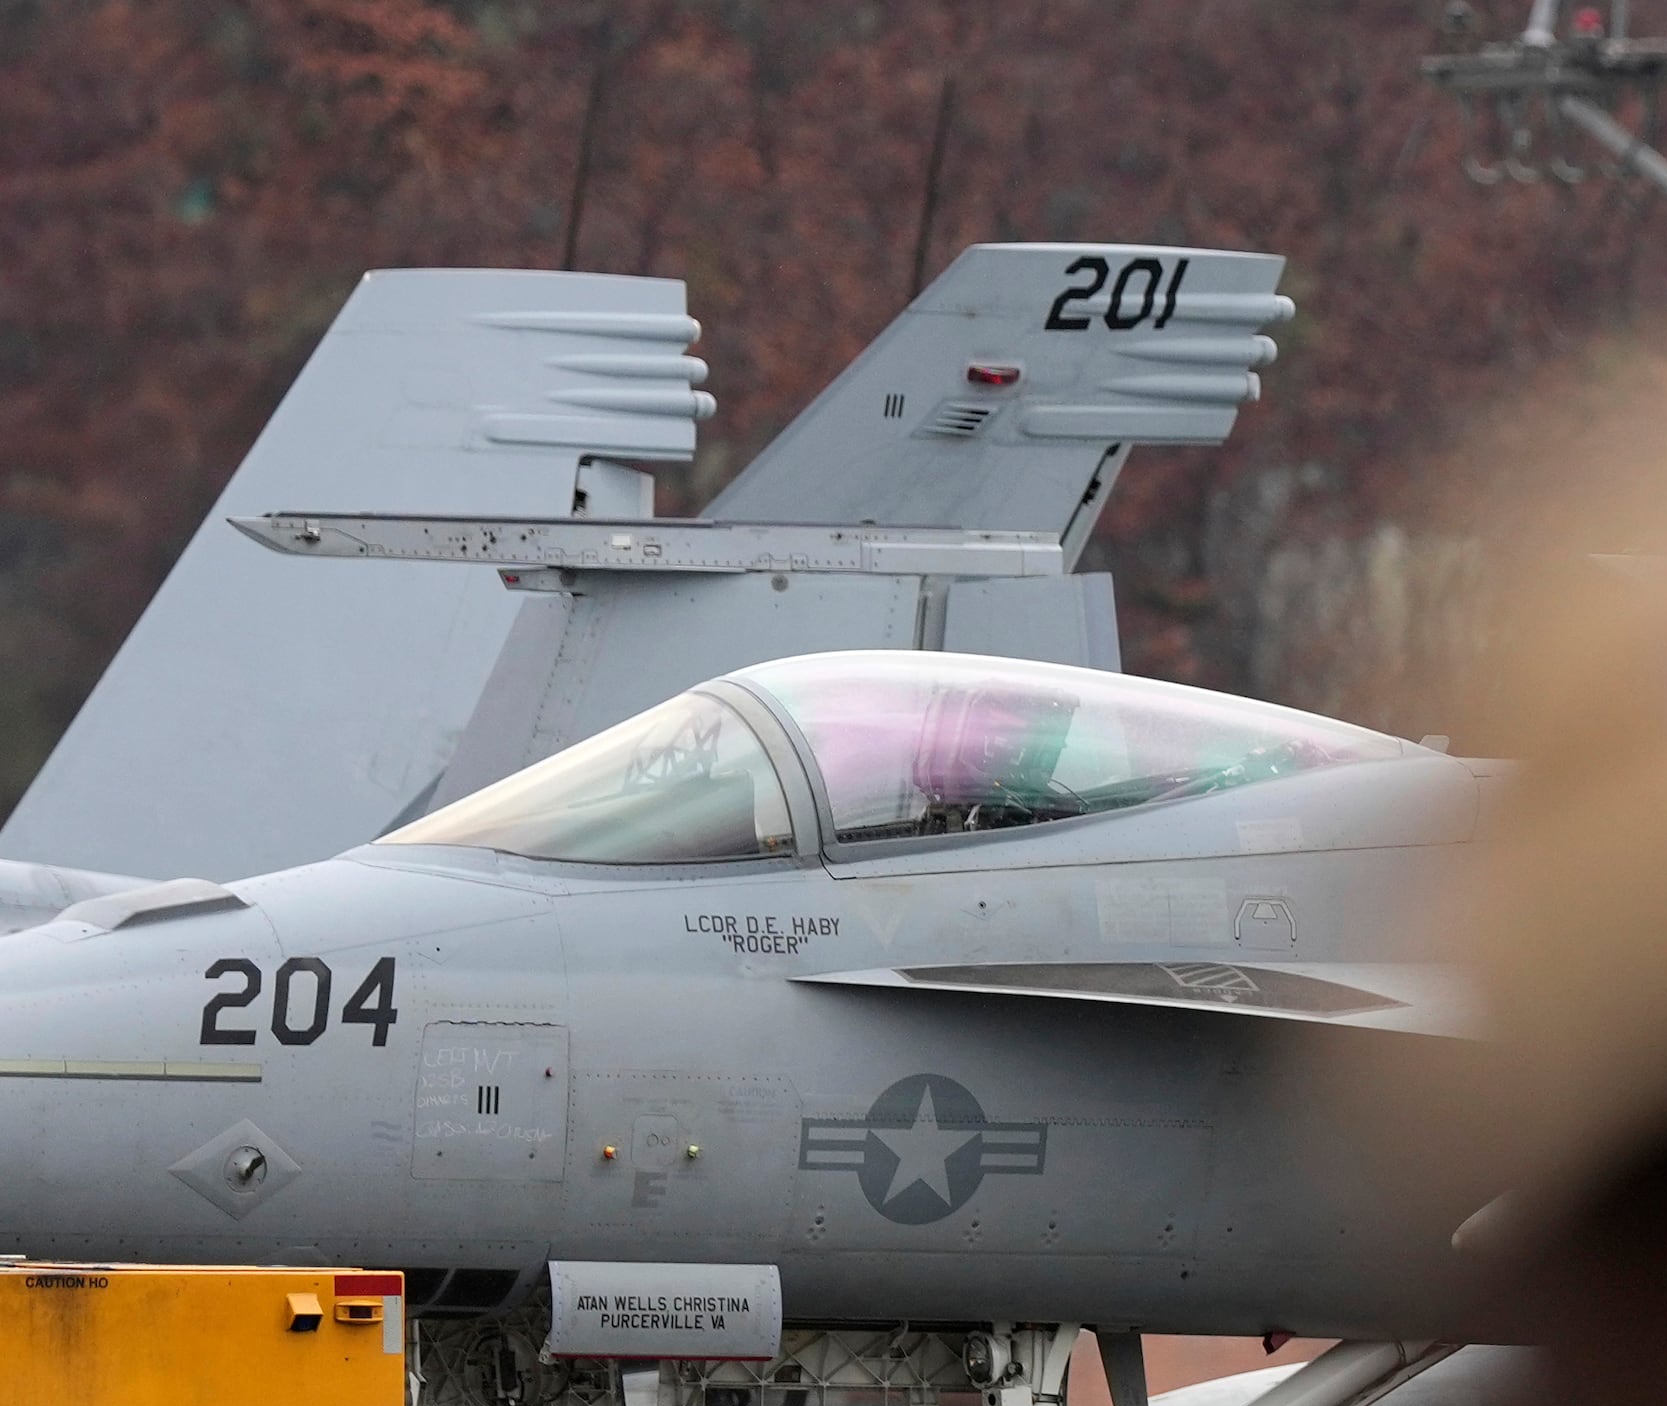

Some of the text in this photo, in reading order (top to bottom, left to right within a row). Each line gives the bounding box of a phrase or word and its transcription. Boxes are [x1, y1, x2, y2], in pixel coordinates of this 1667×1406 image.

[1045, 256, 1190, 331] 201
[684, 914, 841, 937] LCDR D.E. HABY
[722, 934, 810, 955] "ROGER"
[199, 956, 399, 1047] 204
[25, 1276, 86, 1290] CAUTION
[576, 1296, 609, 1312] ATAN
[673, 1296, 751, 1314] CHRISTINA
[710, 1314, 726, 1330] VA
